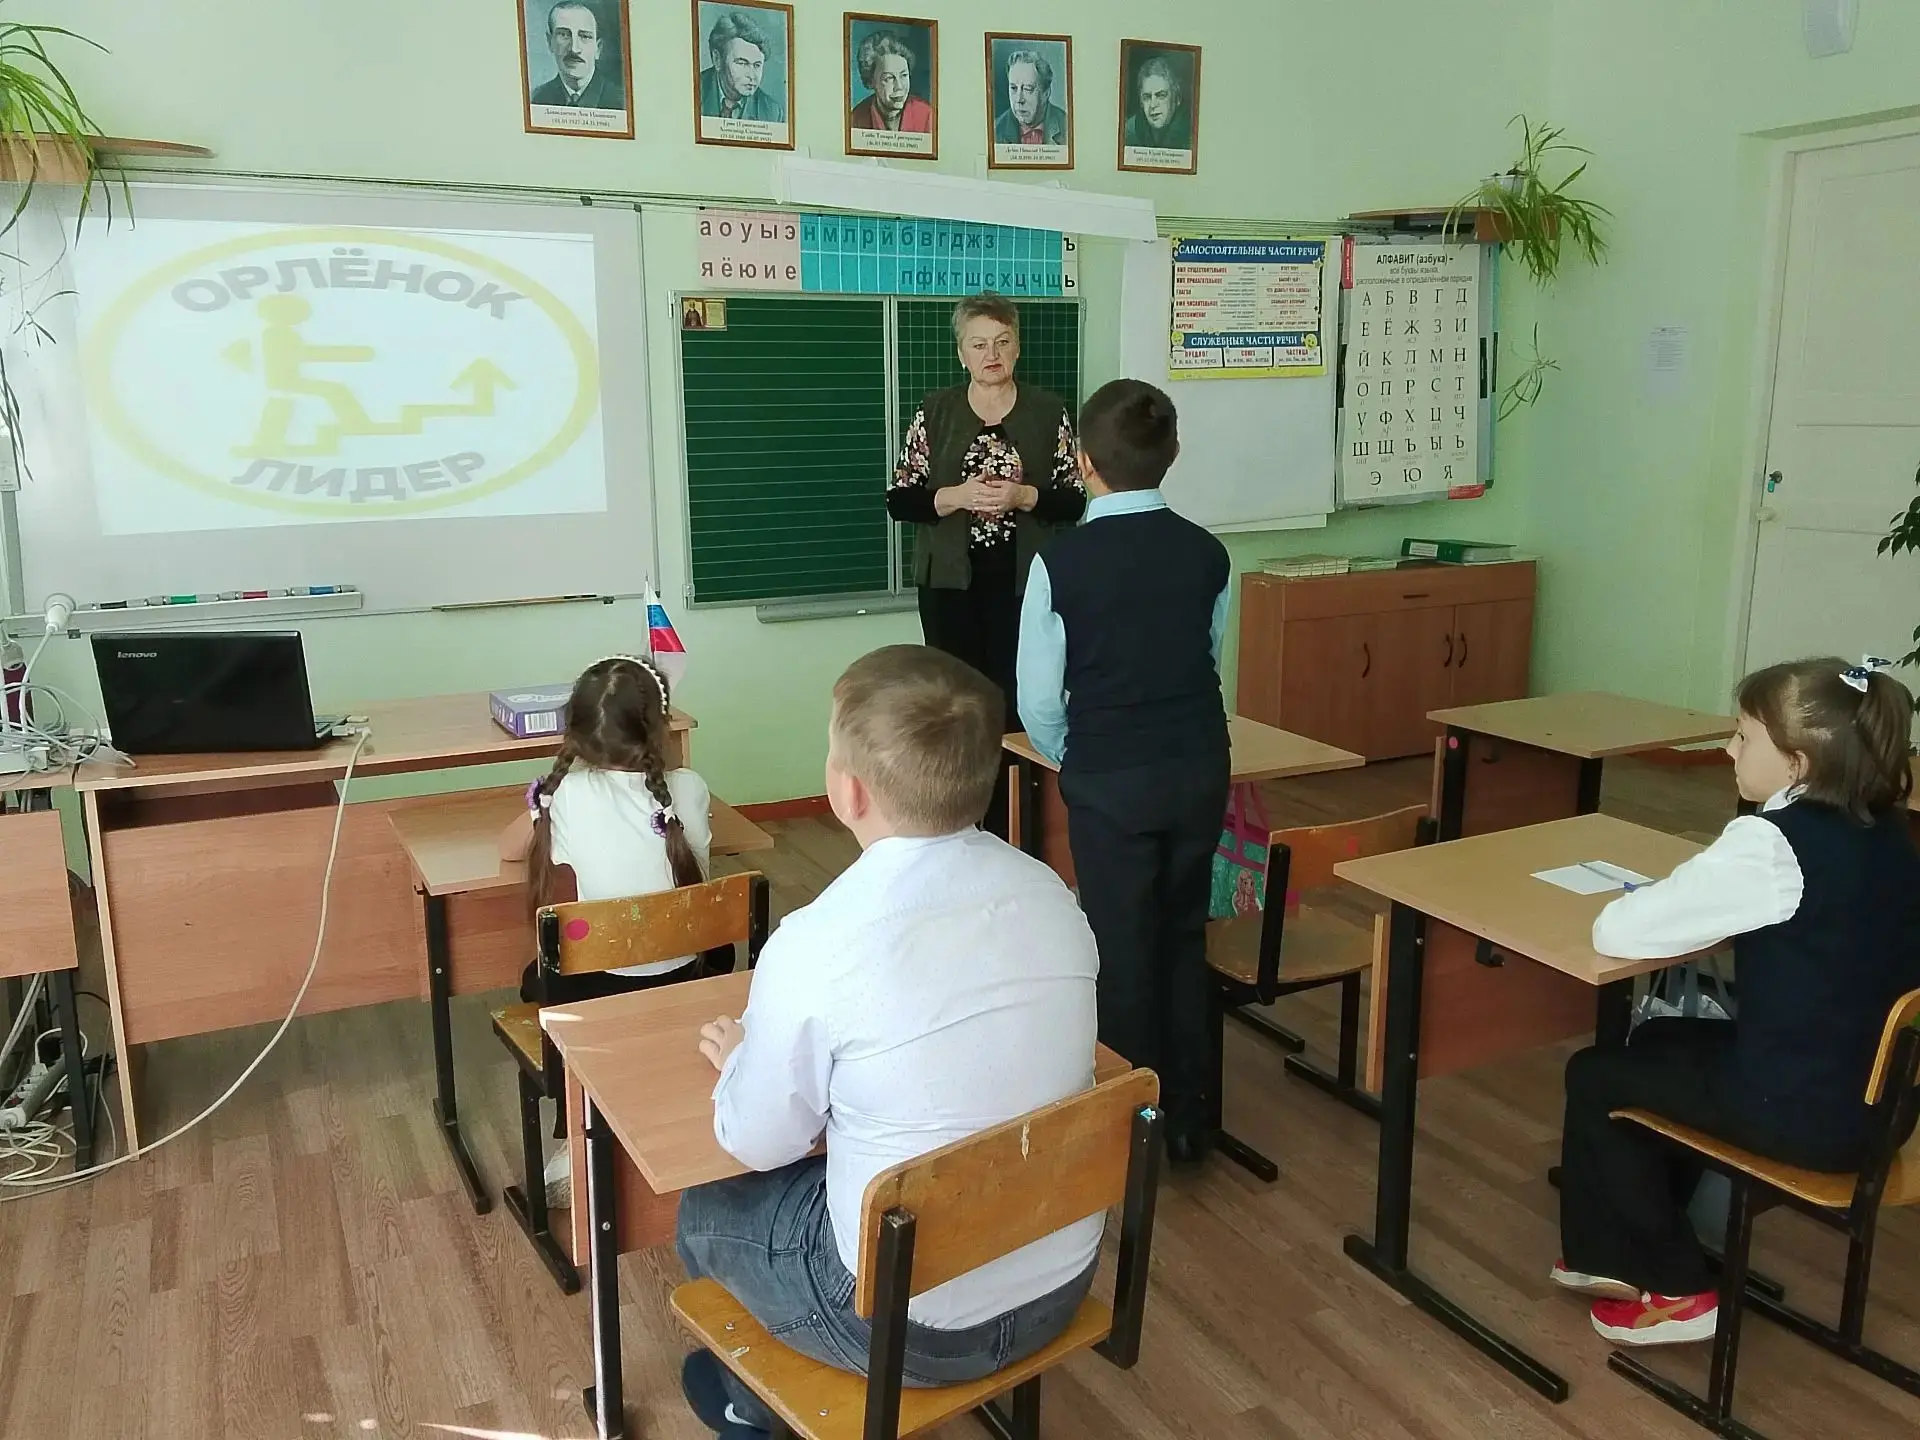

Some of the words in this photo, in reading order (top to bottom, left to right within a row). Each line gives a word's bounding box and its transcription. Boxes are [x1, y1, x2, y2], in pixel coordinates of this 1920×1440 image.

[700, 221, 711, 236] а
[720, 222, 732, 237] о
[740, 223, 752, 243] у
[761, 224, 778, 239] ы
[785, 225, 796, 240] э
[804, 226, 815, 240] н
[824, 227, 837, 242] м
[842, 228, 856, 242] л
[862, 229, 874, 249] р
[882, 225, 894, 245] й
[902, 226, 912, 246] б
[921, 232, 932, 246] в
[940, 233, 948, 248] г
[952, 233, 964, 251] д
[965, 233, 980, 248] ж
[986, 234, 994, 248] з
[1064, 238, 1076, 251] ъ
[1178, 245, 1266, 256] САМОСТОЯТЕЛЬНЫЕ
[1268, 246, 1297, 256] ЧАСТИ
[1298, 246, 1319, 256] РЕЧИ
[1376, 254, 1414, 264] АЛФАВИТ
[1417, 252, 1448, 266] (азбука)
[170, 247, 530, 320] ОРЛЁНОК
[702, 262, 713, 277] я
[722, 257, 732, 278] ё
[740, 264, 756, 278] ю
[764, 264, 776, 279] и
[786, 265, 796, 280] е
[902, 271, 912, 284] п
[918, 266, 932, 290] ф
[940, 272, 949, 285] к
[952, 272, 961, 286] т
[966, 272, 980, 286] ш
[986, 273, 995, 286] с
[1001, 273, 1011, 287] х
[1015, 274, 1026, 290] ц
[1033, 274, 1042, 287] ч
[1048, 274, 1062, 290] щ
[1065, 274, 1076, 287] ь
[1362, 292, 1371, 306] А
[1386, 290, 1394, 305] Б
[1410, 290, 1418, 304] В
[1435, 288, 1443, 304] Г
[1456, 288, 1467, 304] Д
[1362, 322, 1370, 336] Е
[1384, 318, 1392, 336] Ё
[1404, 320, 1419, 334] Ж
[1434, 318, 1442, 334] З
[1456, 318, 1466, 332] И
[1191, 336, 1244, 346] СЛУЖЕБНЫЕ
[1246, 336, 1275, 346] ЧАСТИ
[1276, 336, 1297, 344] РЕЧИ
[1358, 350, 1370, 366] Й
[1382, 351, 1392, 365] К
[1404, 350, 1416, 364] Л
[1430, 349, 1443, 362] М
[1454, 348, 1466, 362] Н
[1358, 382, 1368, 396] О
[1380, 380, 1391, 396] П
[1406, 380, 1415, 394] Р
[1431, 378, 1441, 392] С
[1455, 377, 1464, 391] Т
[1358, 412, 1366, 430] У
[1380, 411, 1392, 424] Ф
[1405, 408, 1414, 422] Х
[1430, 408, 1442, 423] Ц
[1454, 406, 1464, 420] Ч
[1352, 442, 1369, 456] Ш
[1378, 440, 1394, 456] Щ
[1405, 438, 1416, 452] Ъ
[1430, 436, 1442, 450] Ы
[1456, 435, 1464, 448] Ь
[229, 451, 486, 504] ЛИДЕР
[1370, 471, 1382, 486] Э
[1404, 468, 1422, 482] Ю
[1444, 465, 1452, 479] Я
